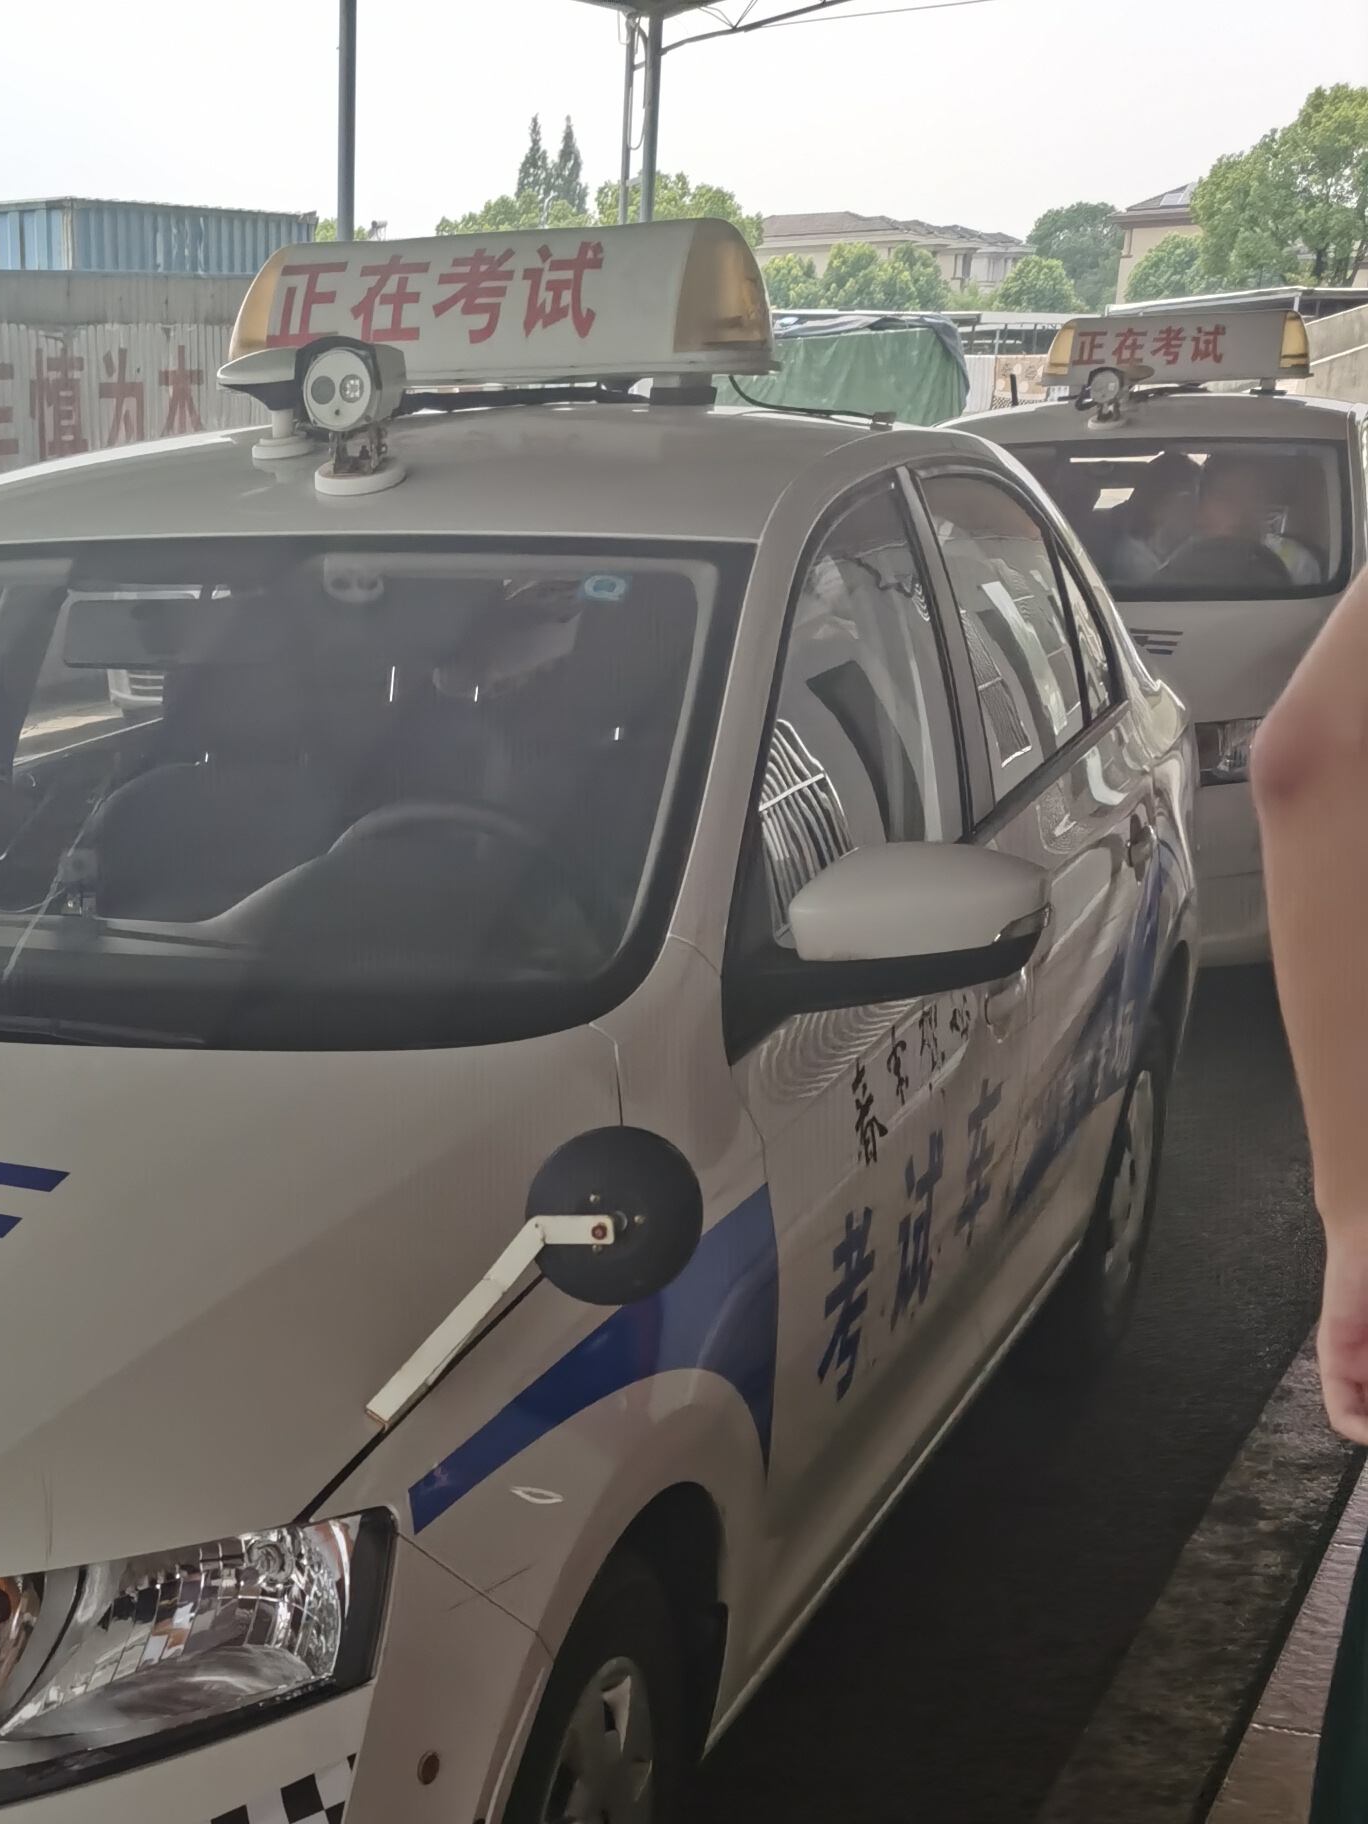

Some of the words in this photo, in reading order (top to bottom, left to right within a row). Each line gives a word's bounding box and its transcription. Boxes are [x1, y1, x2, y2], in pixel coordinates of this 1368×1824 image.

[265, 241, 605, 348] 正在考试
[1071, 323, 1227, 367] 正在考试
[817, 1078, 1003, 1403] 考试车
